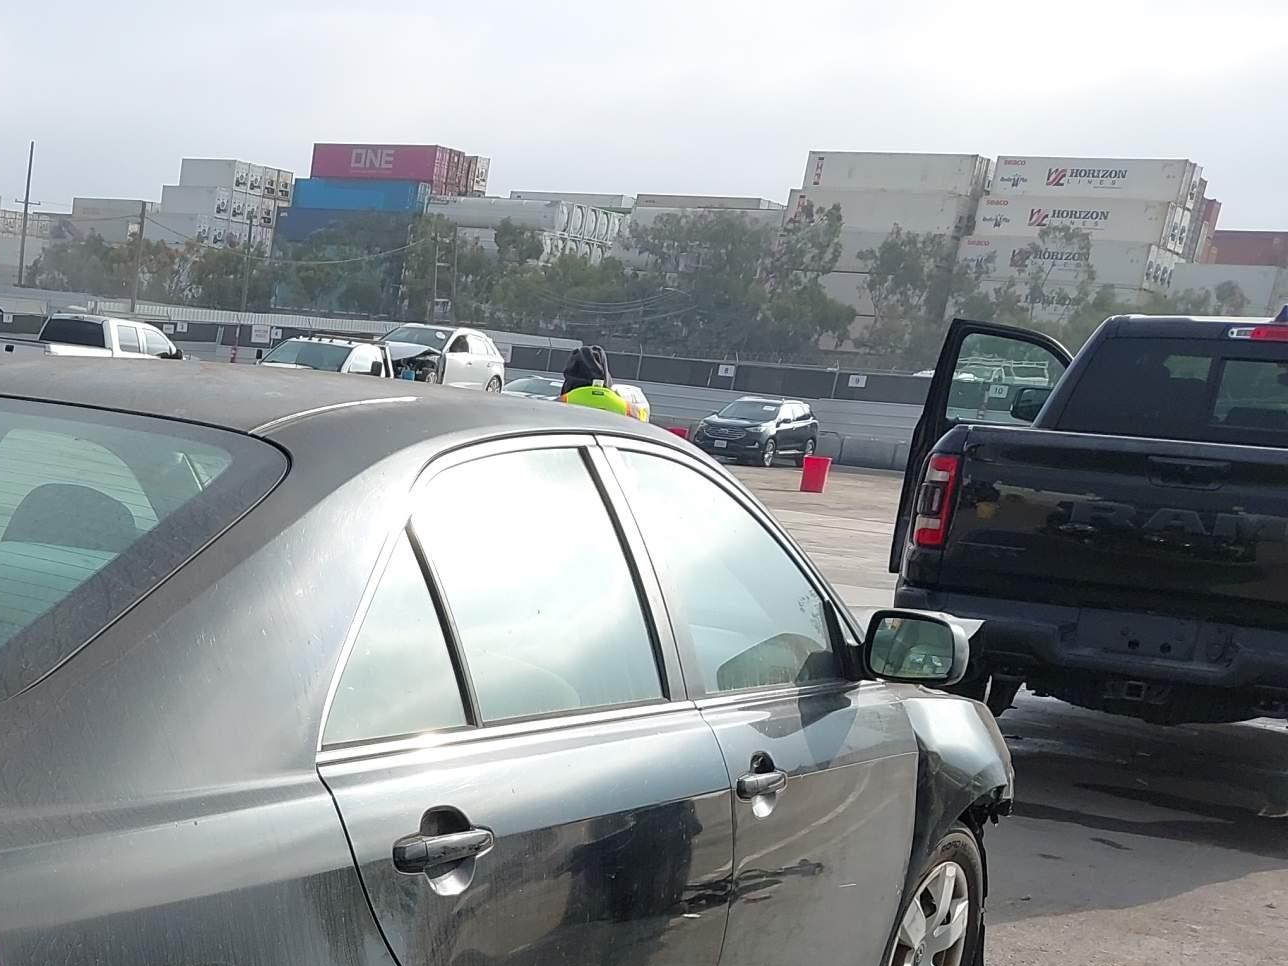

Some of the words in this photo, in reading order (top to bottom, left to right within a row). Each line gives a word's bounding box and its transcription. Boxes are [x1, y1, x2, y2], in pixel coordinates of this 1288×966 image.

[351, 149, 395, 168] ONE
[1068, 168, 1127, 178] HORIZON
[1051, 209, 1110, 220] HORIZON
[1069, 500, 1288, 538] RAM
